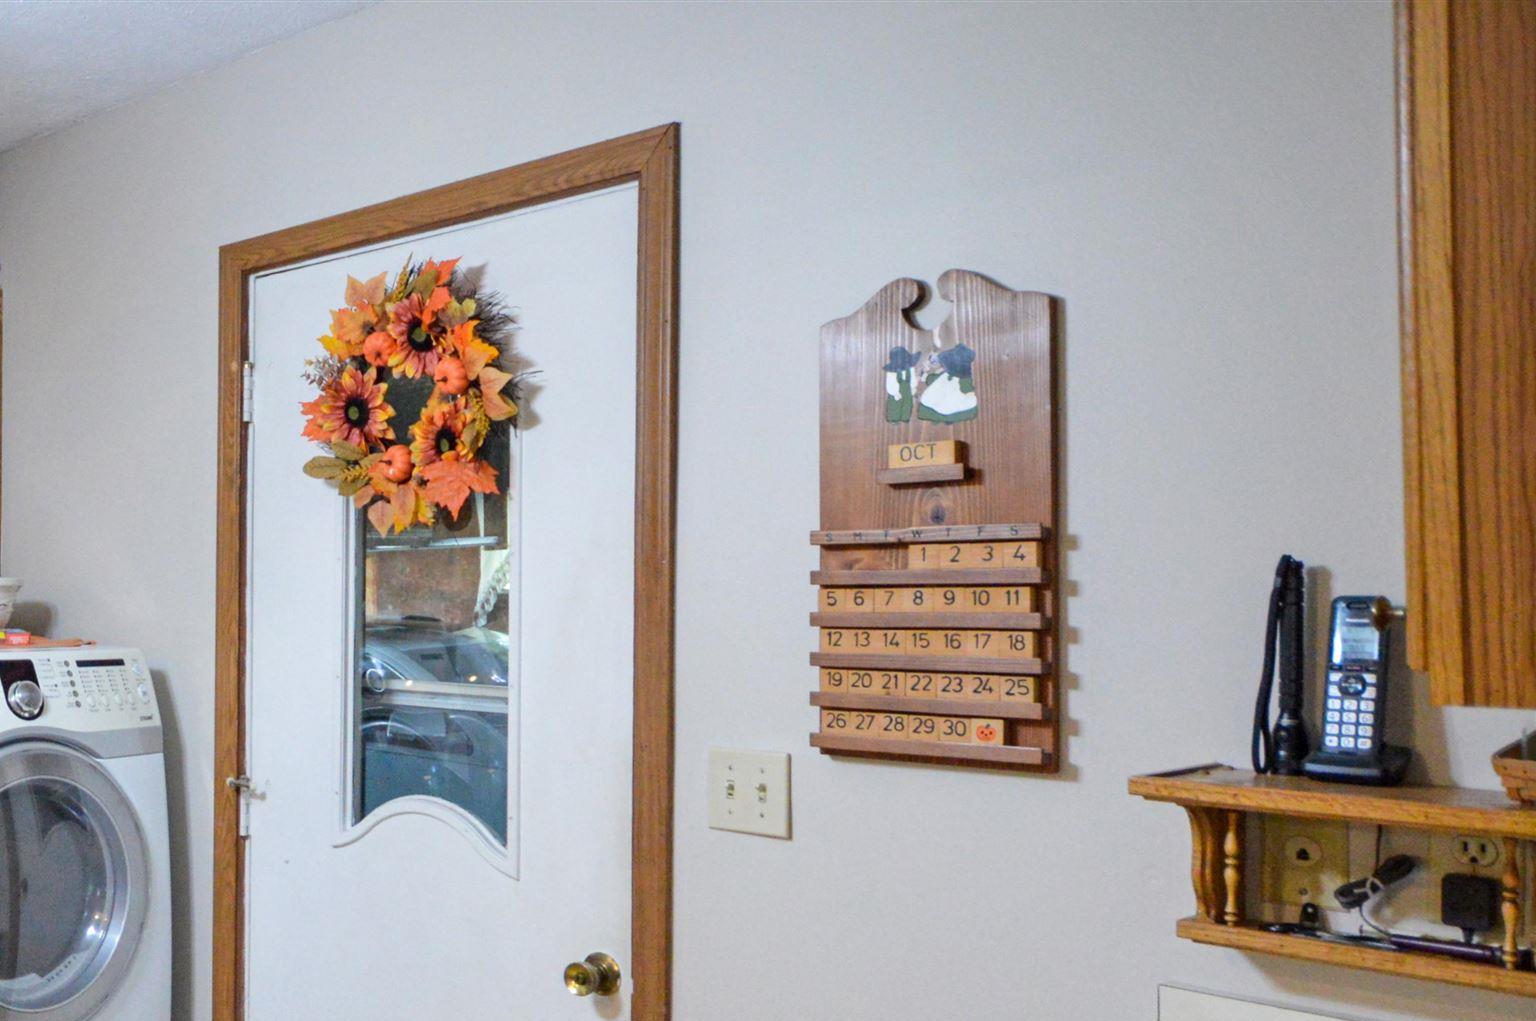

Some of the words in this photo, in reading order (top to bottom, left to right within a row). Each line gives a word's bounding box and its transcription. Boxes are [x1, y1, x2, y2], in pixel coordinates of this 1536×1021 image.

[900, 443, 936, 462] OCT
[825, 533, 833, 542] S
[853, 532, 863, 541] M
[911, 530, 923, 539] W
[944, 528, 952, 537] T
[976, 526, 986, 536] F
[1009, 525, 1019, 535] S
[920, 546, 927, 562] 1
[949, 545, 962, 563] 2
[982, 545, 994, 562] 3
[1013, 544, 1026, 562] 4
[826, 590, 838, 606] 5
[853, 590, 865, 606] 6
[883, 590, 895, 606] 7
[912, 589, 924, 606] 8
[943, 589, 956, 606] 9
[971, 589, 991, 606] 10
[1005, 589, 1021, 606] 11
[826, 631, 843, 647] 12
[853, 631, 871, 648] 13
[882, 632, 900, 648] 14
[911, 632, 930, 649] 15
[943, 633, 962, 650] 16
[974, 633, 992, 649] 17
[1007, 634, 1026, 651] 18
[826, 671, 843, 687] 19
[850, 672, 873, 689] 20
[881, 673, 899, 690] 21
[910, 674, 933, 692] 22
[940, 675, 964, 693] 23
[971, 676, 994, 694] 24
[1004, 678, 1030, 696] 25
[825, 712, 847, 729] 26
[854, 713, 876, 730] 27
[882, 715, 905, 732] 28
[911, 716, 935, 734] 29
[942, 719, 967, 737] 30
